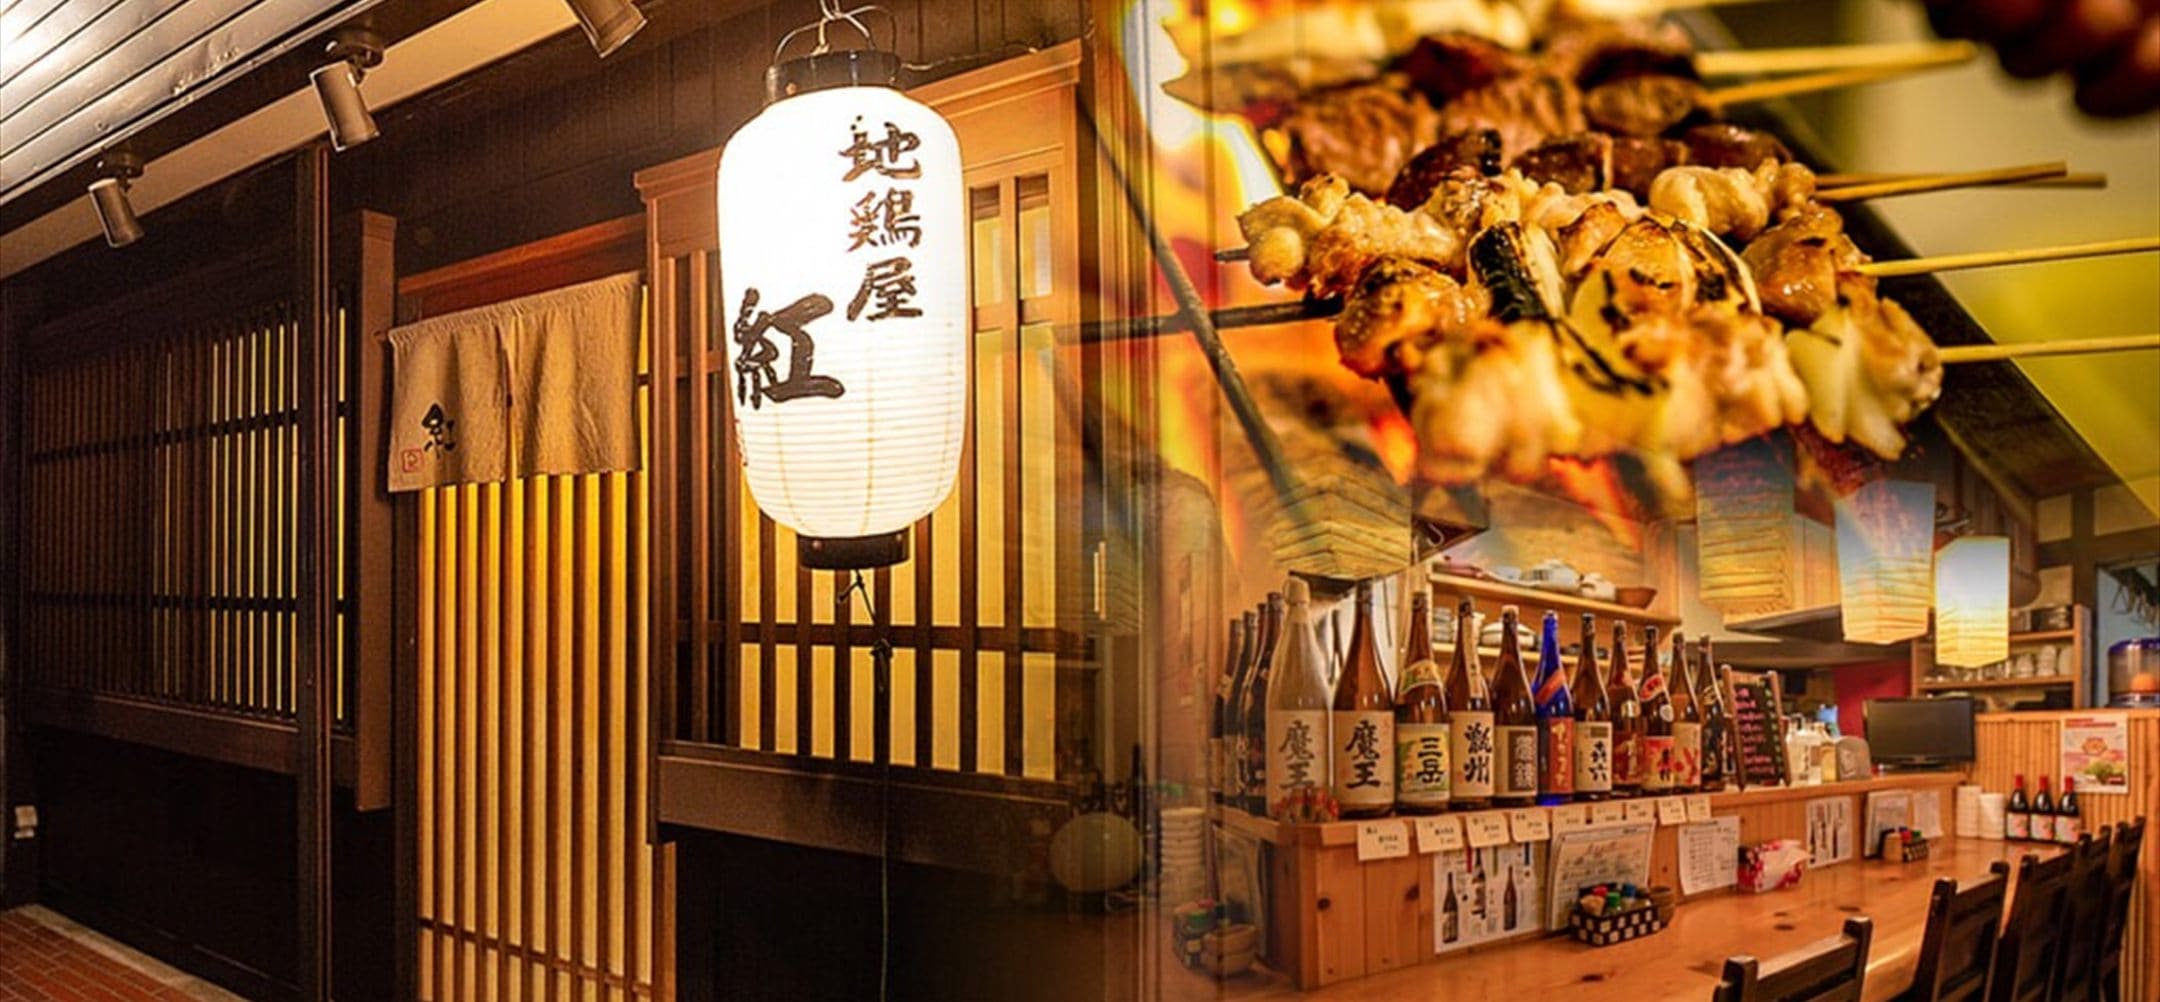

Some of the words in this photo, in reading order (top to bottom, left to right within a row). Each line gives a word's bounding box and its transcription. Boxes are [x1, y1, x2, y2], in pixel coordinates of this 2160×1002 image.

[838, 115, 924, 322] 地鶏屋
[733, 288, 846, 409] 紅
[421, 403, 456, 460] 紅
[1278, 719, 1316, 789] 魔王
[1345, 719, 1381, 789] 魔王
[1416, 737, 1444, 784] 三岳
